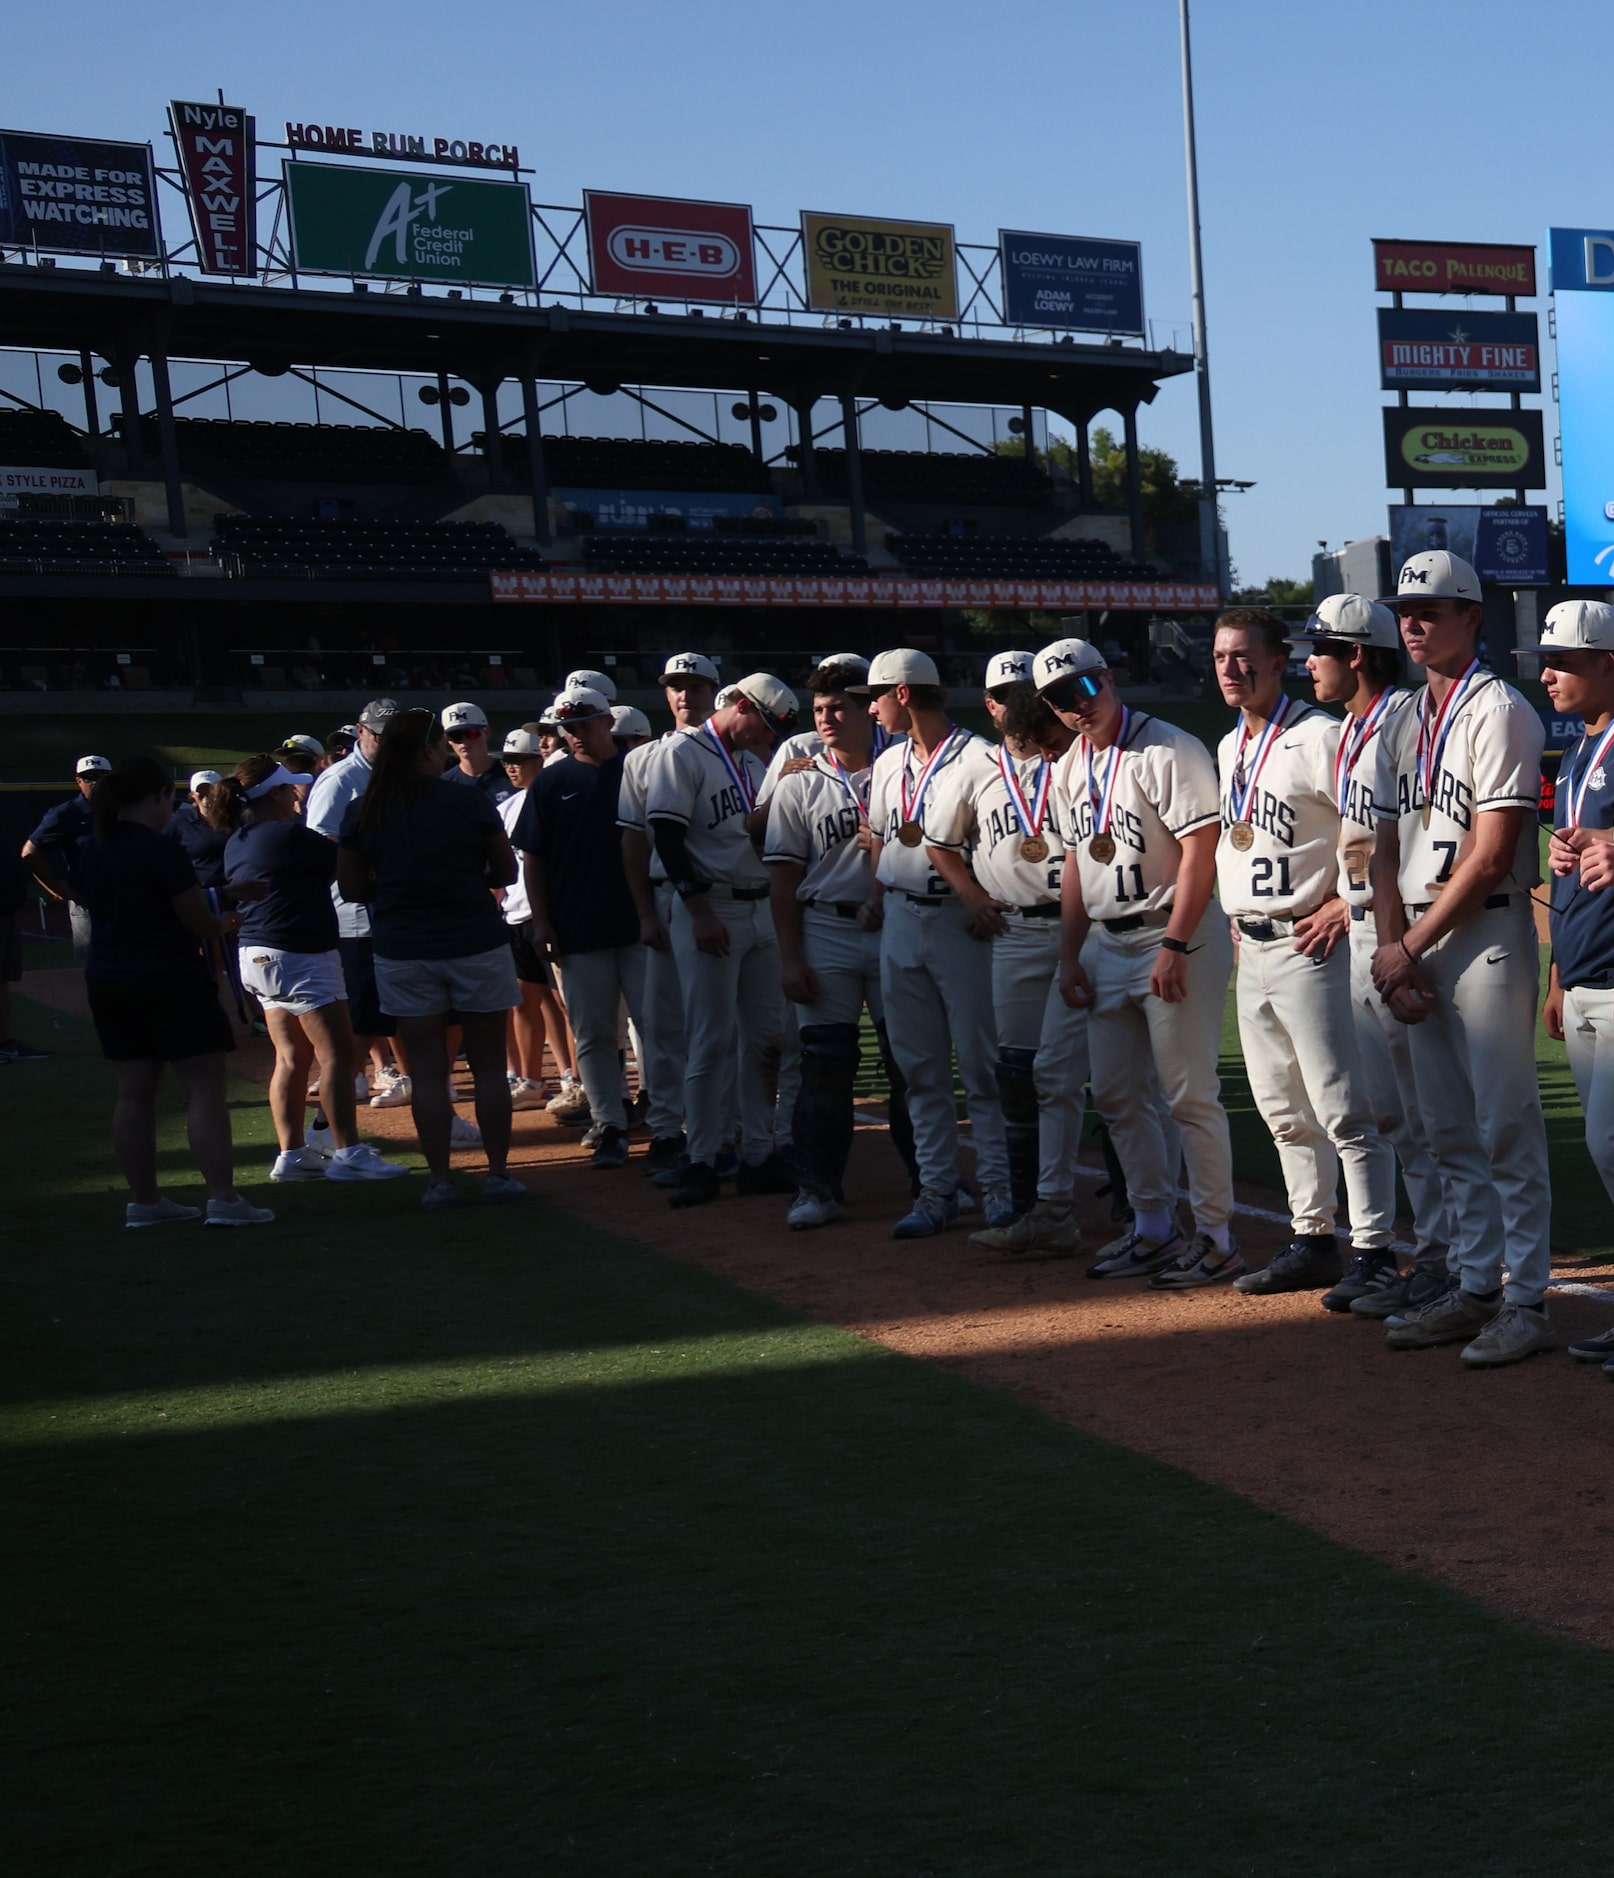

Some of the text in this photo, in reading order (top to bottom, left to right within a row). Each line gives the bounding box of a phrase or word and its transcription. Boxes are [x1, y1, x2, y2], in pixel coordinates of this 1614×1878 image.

[184, 105, 238, 130] Nyle
[286, 122, 519, 167] HOME RUN PORCH
[17, 161, 143, 185] MADE FOR
[20, 179, 146, 206] EXPRESS
[195, 135, 240, 270] MAXWELL
[22, 200, 149, 229] WATCHING
[412, 223, 474, 241] Federal
[413, 237, 464, 254] Credit
[818, 228, 943, 259] GOLDEN
[414, 250, 462, 266] Union
[832, 252, 930, 277] CHICK
[1012, 250, 1135, 272] LOEWY LAW FIRM
[1383, 259, 1528, 282] TACO PALENQUE
[830, 279, 942, 299] THE ORIGINAL
[1036, 289, 1071, 301] ADAM
[1034, 300, 1075, 312] LOEWY
[1392, 345, 1527, 368] MIGHTY FINE
[1395, 369, 1440, 377] BURGERS
[1488, 370, 1526, 378] SHAKES
[1421, 431, 1514, 451] Chicken
[7, 475, 47, 488] STYLE
[51, 476, 86, 489] PIZZA
[1400, 567, 1430, 585] FM
[676, 659, 697, 670] FM
[1000, 661, 1027, 675] FM
[1044, 653, 1075, 673] FM
[1432, 841, 1457, 883] 7
[1115, 864, 1149, 902] 11
[1251, 856, 1295, 896] 21
